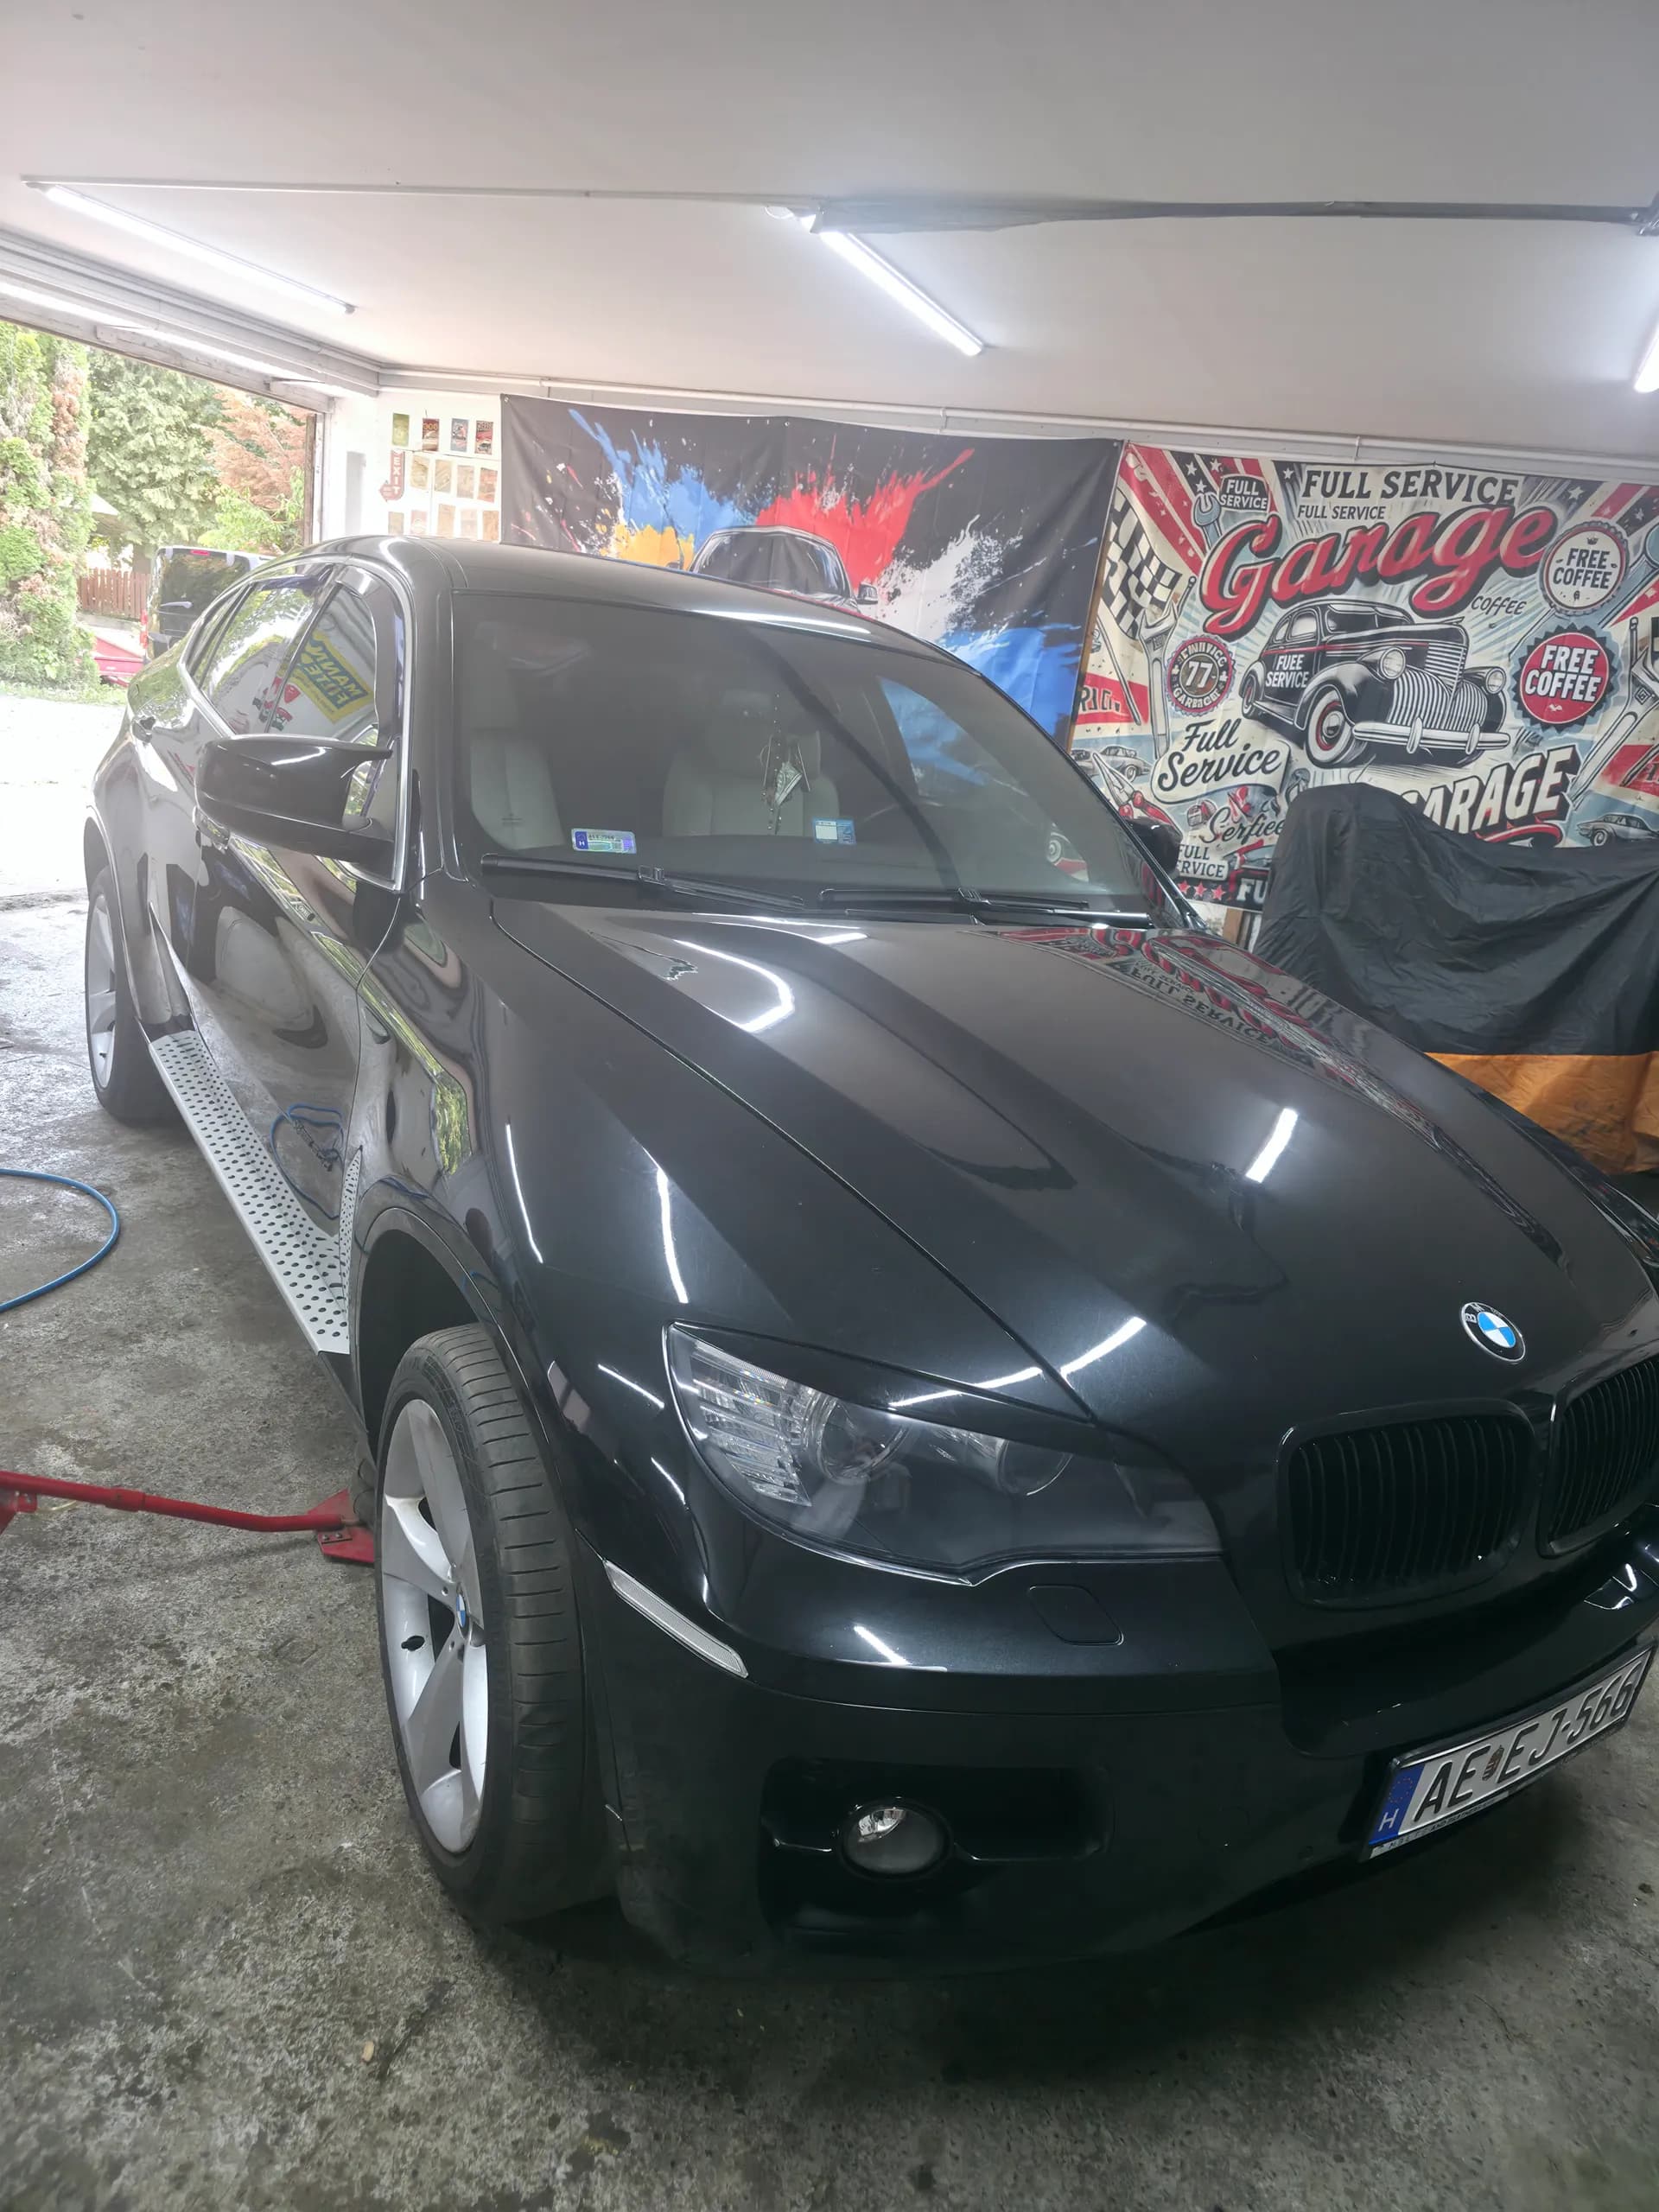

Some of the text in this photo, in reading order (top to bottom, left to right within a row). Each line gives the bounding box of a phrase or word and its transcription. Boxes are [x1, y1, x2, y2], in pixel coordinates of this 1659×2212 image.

[393, 457, 402, 494] EXIT
[1225, 479, 1260, 497] FULL
[1302, 469, 1519, 505] FULL SERVICE
[1220, 494, 1268, 511] SERVICE
[1298, 505, 1386, 520] FULL SERVICE
[1566, 548, 1611, 569] FREE
[1200, 505, 1557, 641] Garage
[1553, 567, 1612, 589] COFFEE
[1541, 645, 1599, 673] FREE
[1185, 660, 1214, 689] 77
[1265, 671, 1310, 690] SERVICE
[1524, 670, 1602, 702] COFFEE
[1182, 718, 1242, 753] Full
[1158, 743, 1282, 791] Service
[1178, 844, 1210, 860] FULL
[1179, 860, 1225, 878] RVICE
[1413, 1660, 1643, 1822] AE EJ-566
[1377, 1808, 1400, 1832] H
